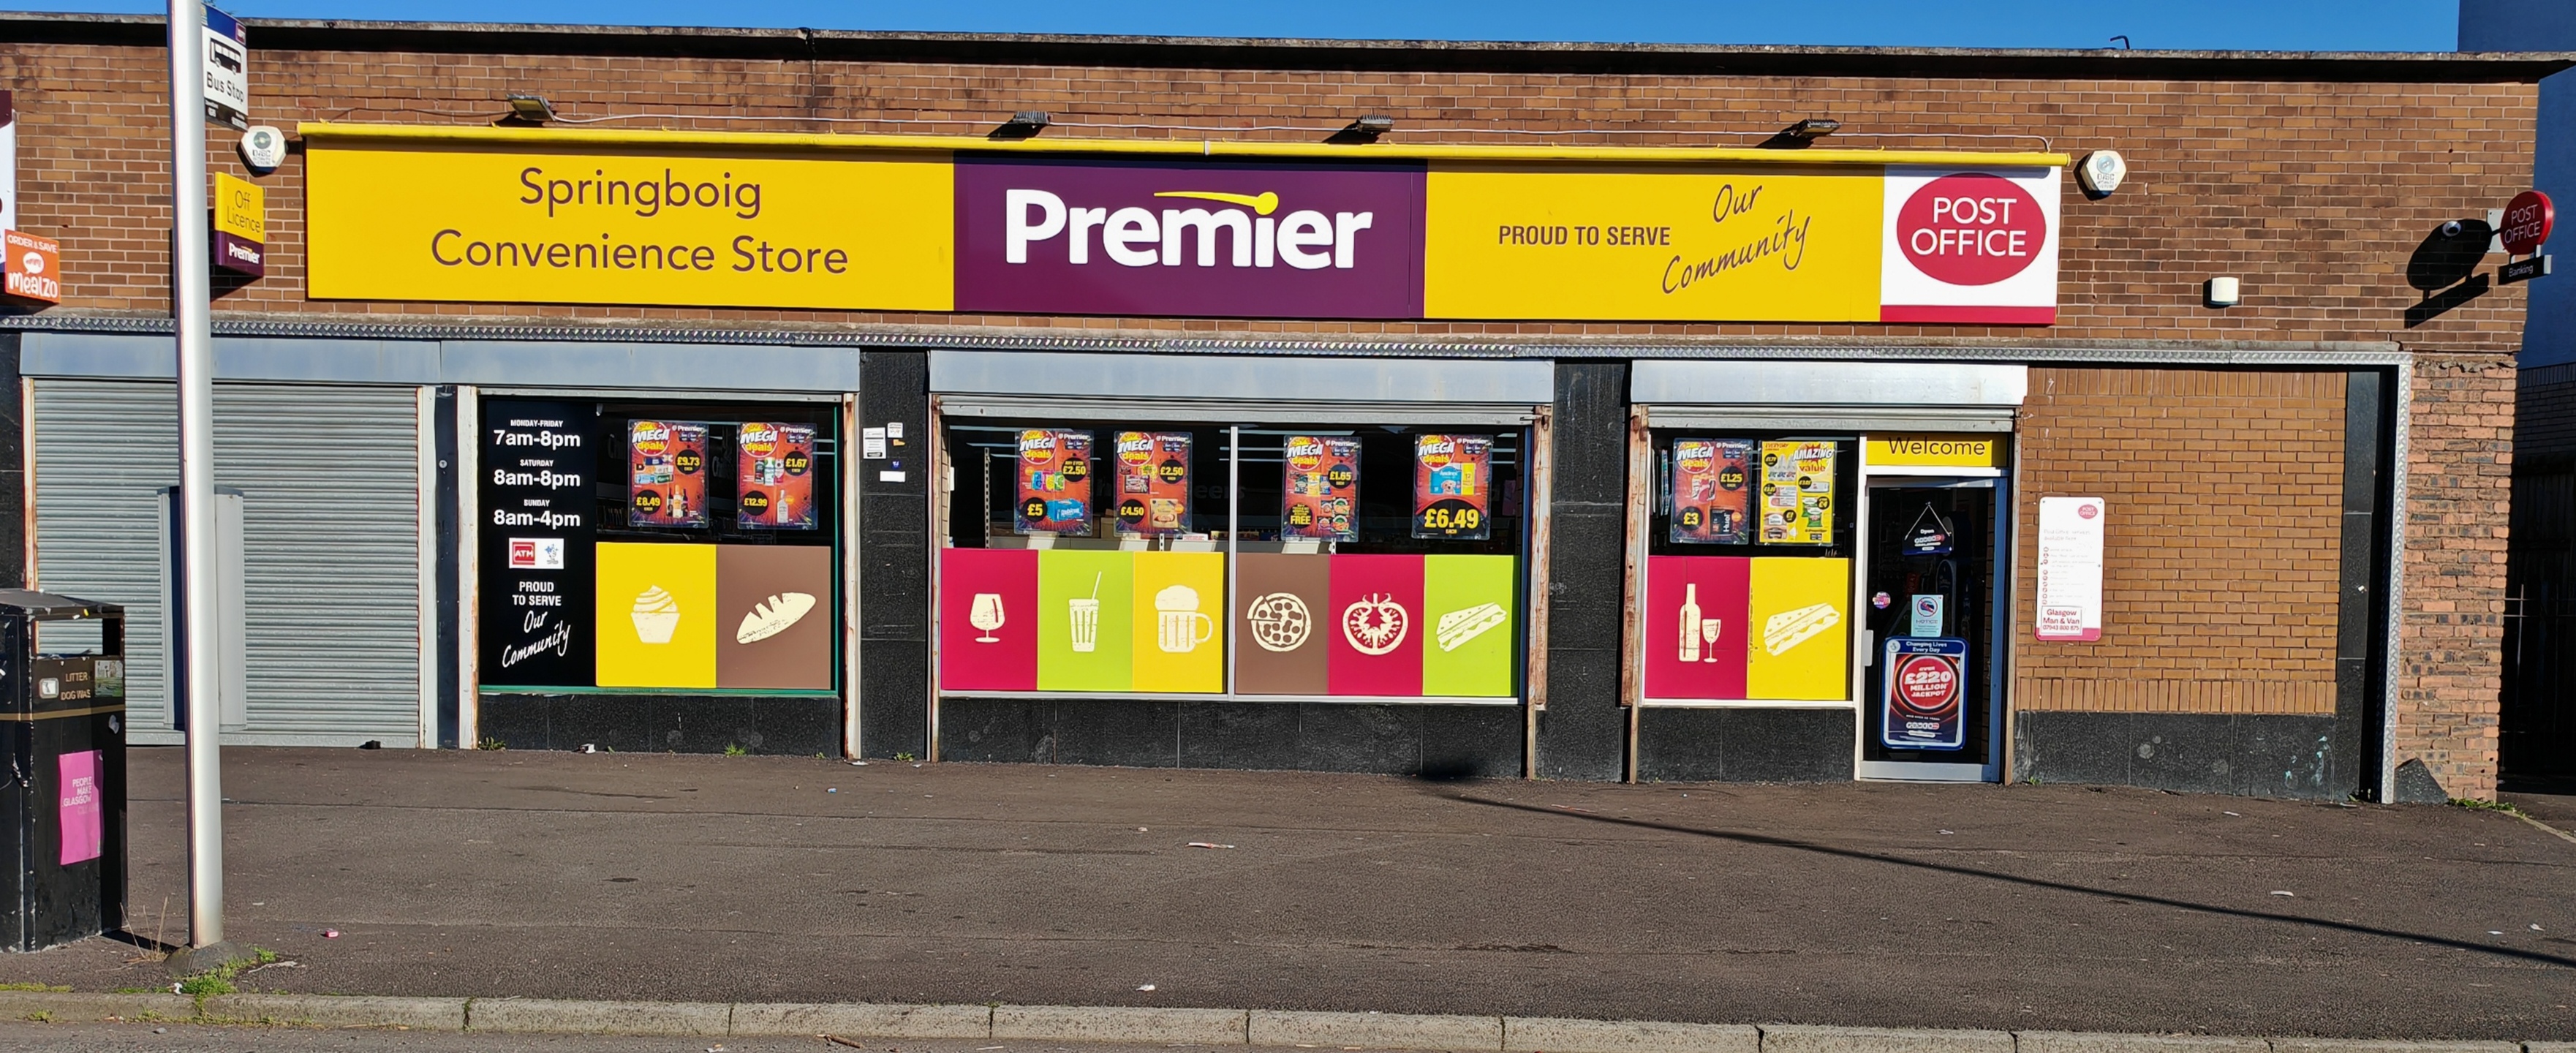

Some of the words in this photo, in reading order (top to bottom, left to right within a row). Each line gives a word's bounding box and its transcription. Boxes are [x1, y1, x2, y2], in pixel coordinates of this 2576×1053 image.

[207, 72, 224, 93] Bus
[227, 80, 244, 104] Stop
[519, 166, 761, 219] Springboig
[235, 190, 250, 211] Off
[1713, 184, 1762, 222] Our
[1933, 197, 2017, 224] POST
[2511, 204, 2538, 224] POST
[227, 205, 260, 233] Licence
[1006, 189, 1373, 269] Premier
[1498, 225, 1568, 245] PROUD
[1574, 227, 1599, 245] TO
[1606, 227, 1671, 246] SERVE
[2504, 221, 2541, 244] OFFICE
[7, 235, 32, 248] ORDER
[38, 241, 58, 254] SAVE
[1911, 228, 2027, 257] OFFICE
[229, 242, 260, 264] Premier
[431, 228, 715, 271] Convenience
[730, 235, 849, 275] Store
[1662, 209, 1810, 294] Community
[2509, 264, 2534, 277] Banking
[510, 420, 563, 428] MONDAY-FRIDAY
[494, 429, 581, 450] 7am-8pm
[632, 429, 671, 443] MEGA
[740, 430, 778, 444] MEGA
[637, 441, 665, 450] deals
[745, 442, 772, 451] deals
[1019, 437, 1057, 451] MEGA
[1117, 439, 1154, 453] MEGA
[1419, 442, 1455, 456] MEGA
[1888, 436, 1985, 455] Welcome
[1024, 450, 1052, 458] deals
[1122, 452, 1149, 460] deals
[1287, 444, 1323, 458] MEGA
[1677, 447, 1715, 461] MEGA
[1794, 448, 1835, 461] AMAZING
[677, 457, 700, 466] £9.73
[785, 458, 807, 468] £1.67
[1291, 457, 1318, 465] deals
[1423, 455, 1449, 463] deals
[1682, 458, 1709, 467] deals
[1063, 466, 1086, 475] £2.50
[1160, 467, 1183, 475] £2.50
[494, 469, 581, 490] 8am-8pm
[1721, 474, 1742, 483] £1.25
[636, 497, 660, 506] £8.49
[744, 498, 768, 506] £12.99
[1027, 504, 1043, 516] £5
[1121, 507, 1144, 516] £4.50
[494, 509, 581, 530] 8am-4pm
[1291, 516, 1311, 524] FREE
[1424, 508, 1478, 529] £6.49
[1683, 512, 1699, 525] £3
[519, 581, 554, 592] PROUD
[512, 595, 526, 605] TO
[529, 595, 562, 606] SERVE
[2047, 608, 2077, 617] Glasgow
[524, 610, 548, 633] Our
[502, 620, 570, 668] Community
[66, 672, 88, 682] LITTER
[1904, 671, 1952, 684] £220
[1910, 684, 1948, 692] MILLION
[61, 691, 76, 701] DOG
[72, 777, 91, 788] PEOPLE
[77, 785, 91, 796] MAKE
[63, 795, 91, 807] GLASGOW
